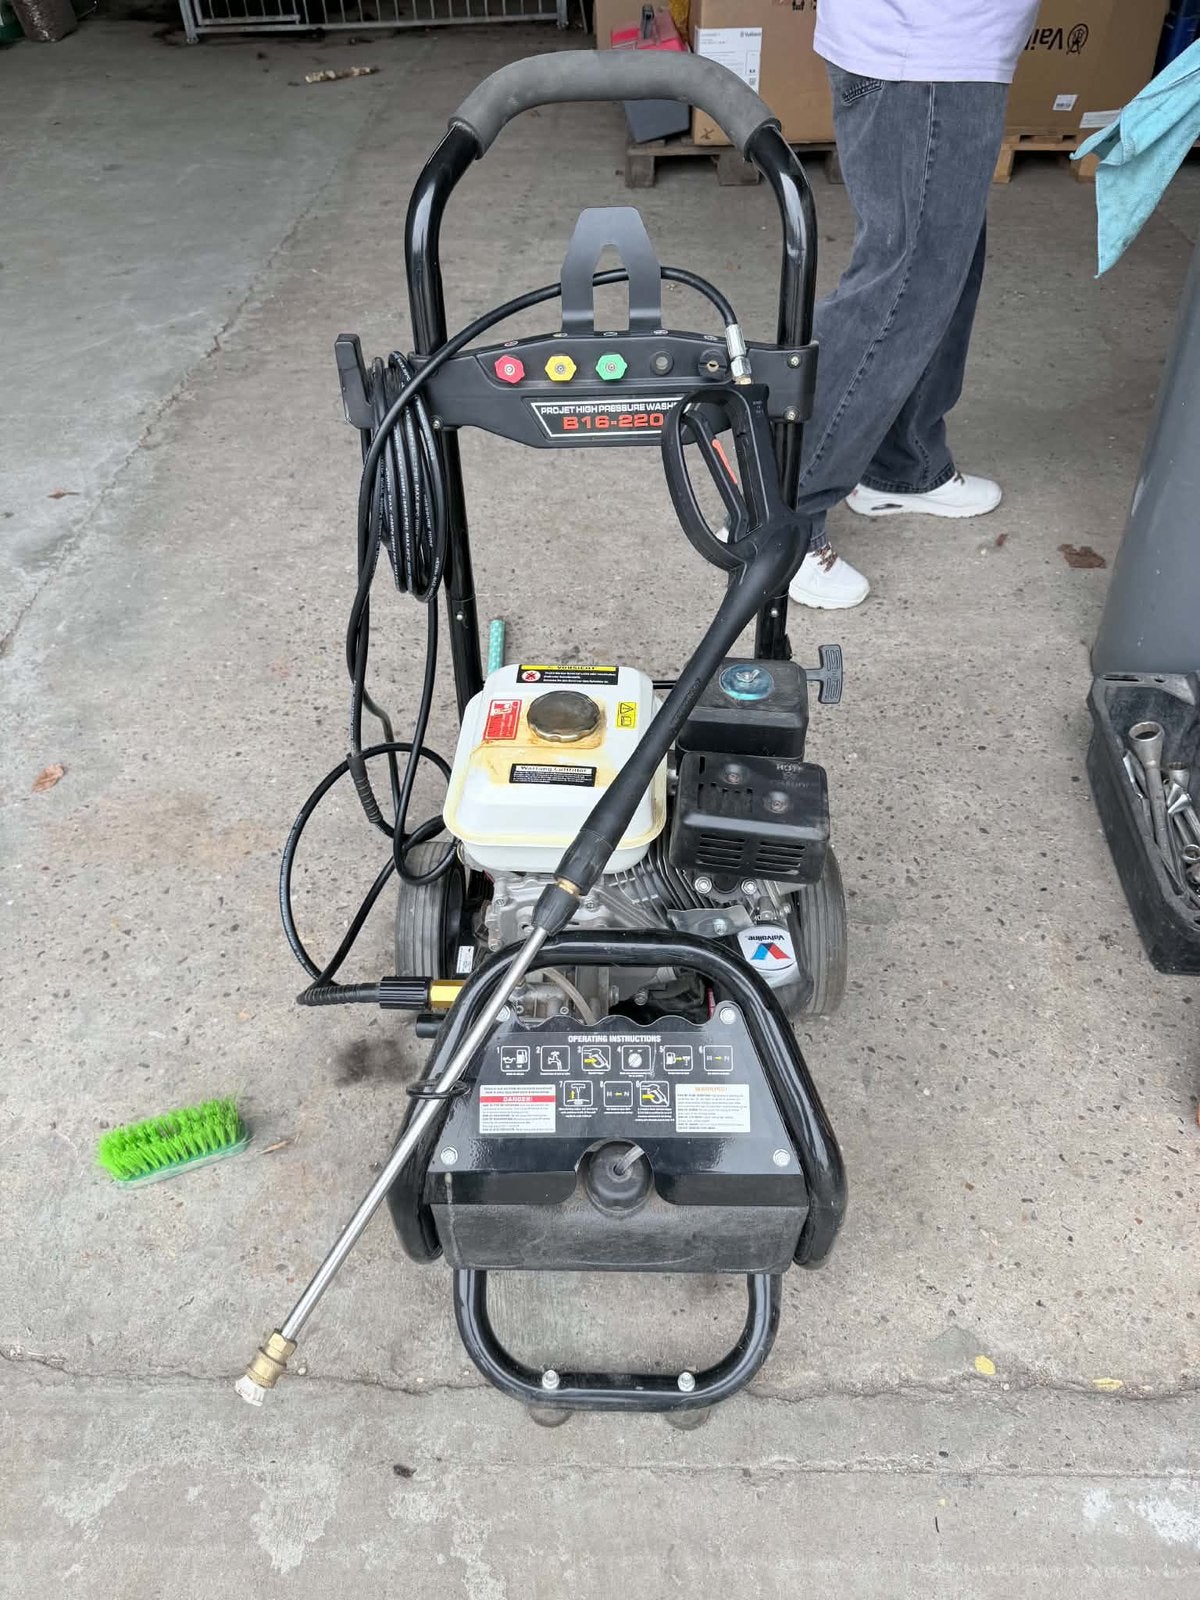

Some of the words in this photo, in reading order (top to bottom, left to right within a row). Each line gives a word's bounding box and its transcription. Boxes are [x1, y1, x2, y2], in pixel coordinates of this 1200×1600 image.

[541, 406, 576, 415] PROJET
[576, 405, 598, 414] HIGH
[598, 403, 645, 413] PRESSURE
[563, 413, 664, 430] B16-220
[567, 1034, 608, 1043] OPERATING
[609, 1034, 662, 1043] INSTRUCTIONS
